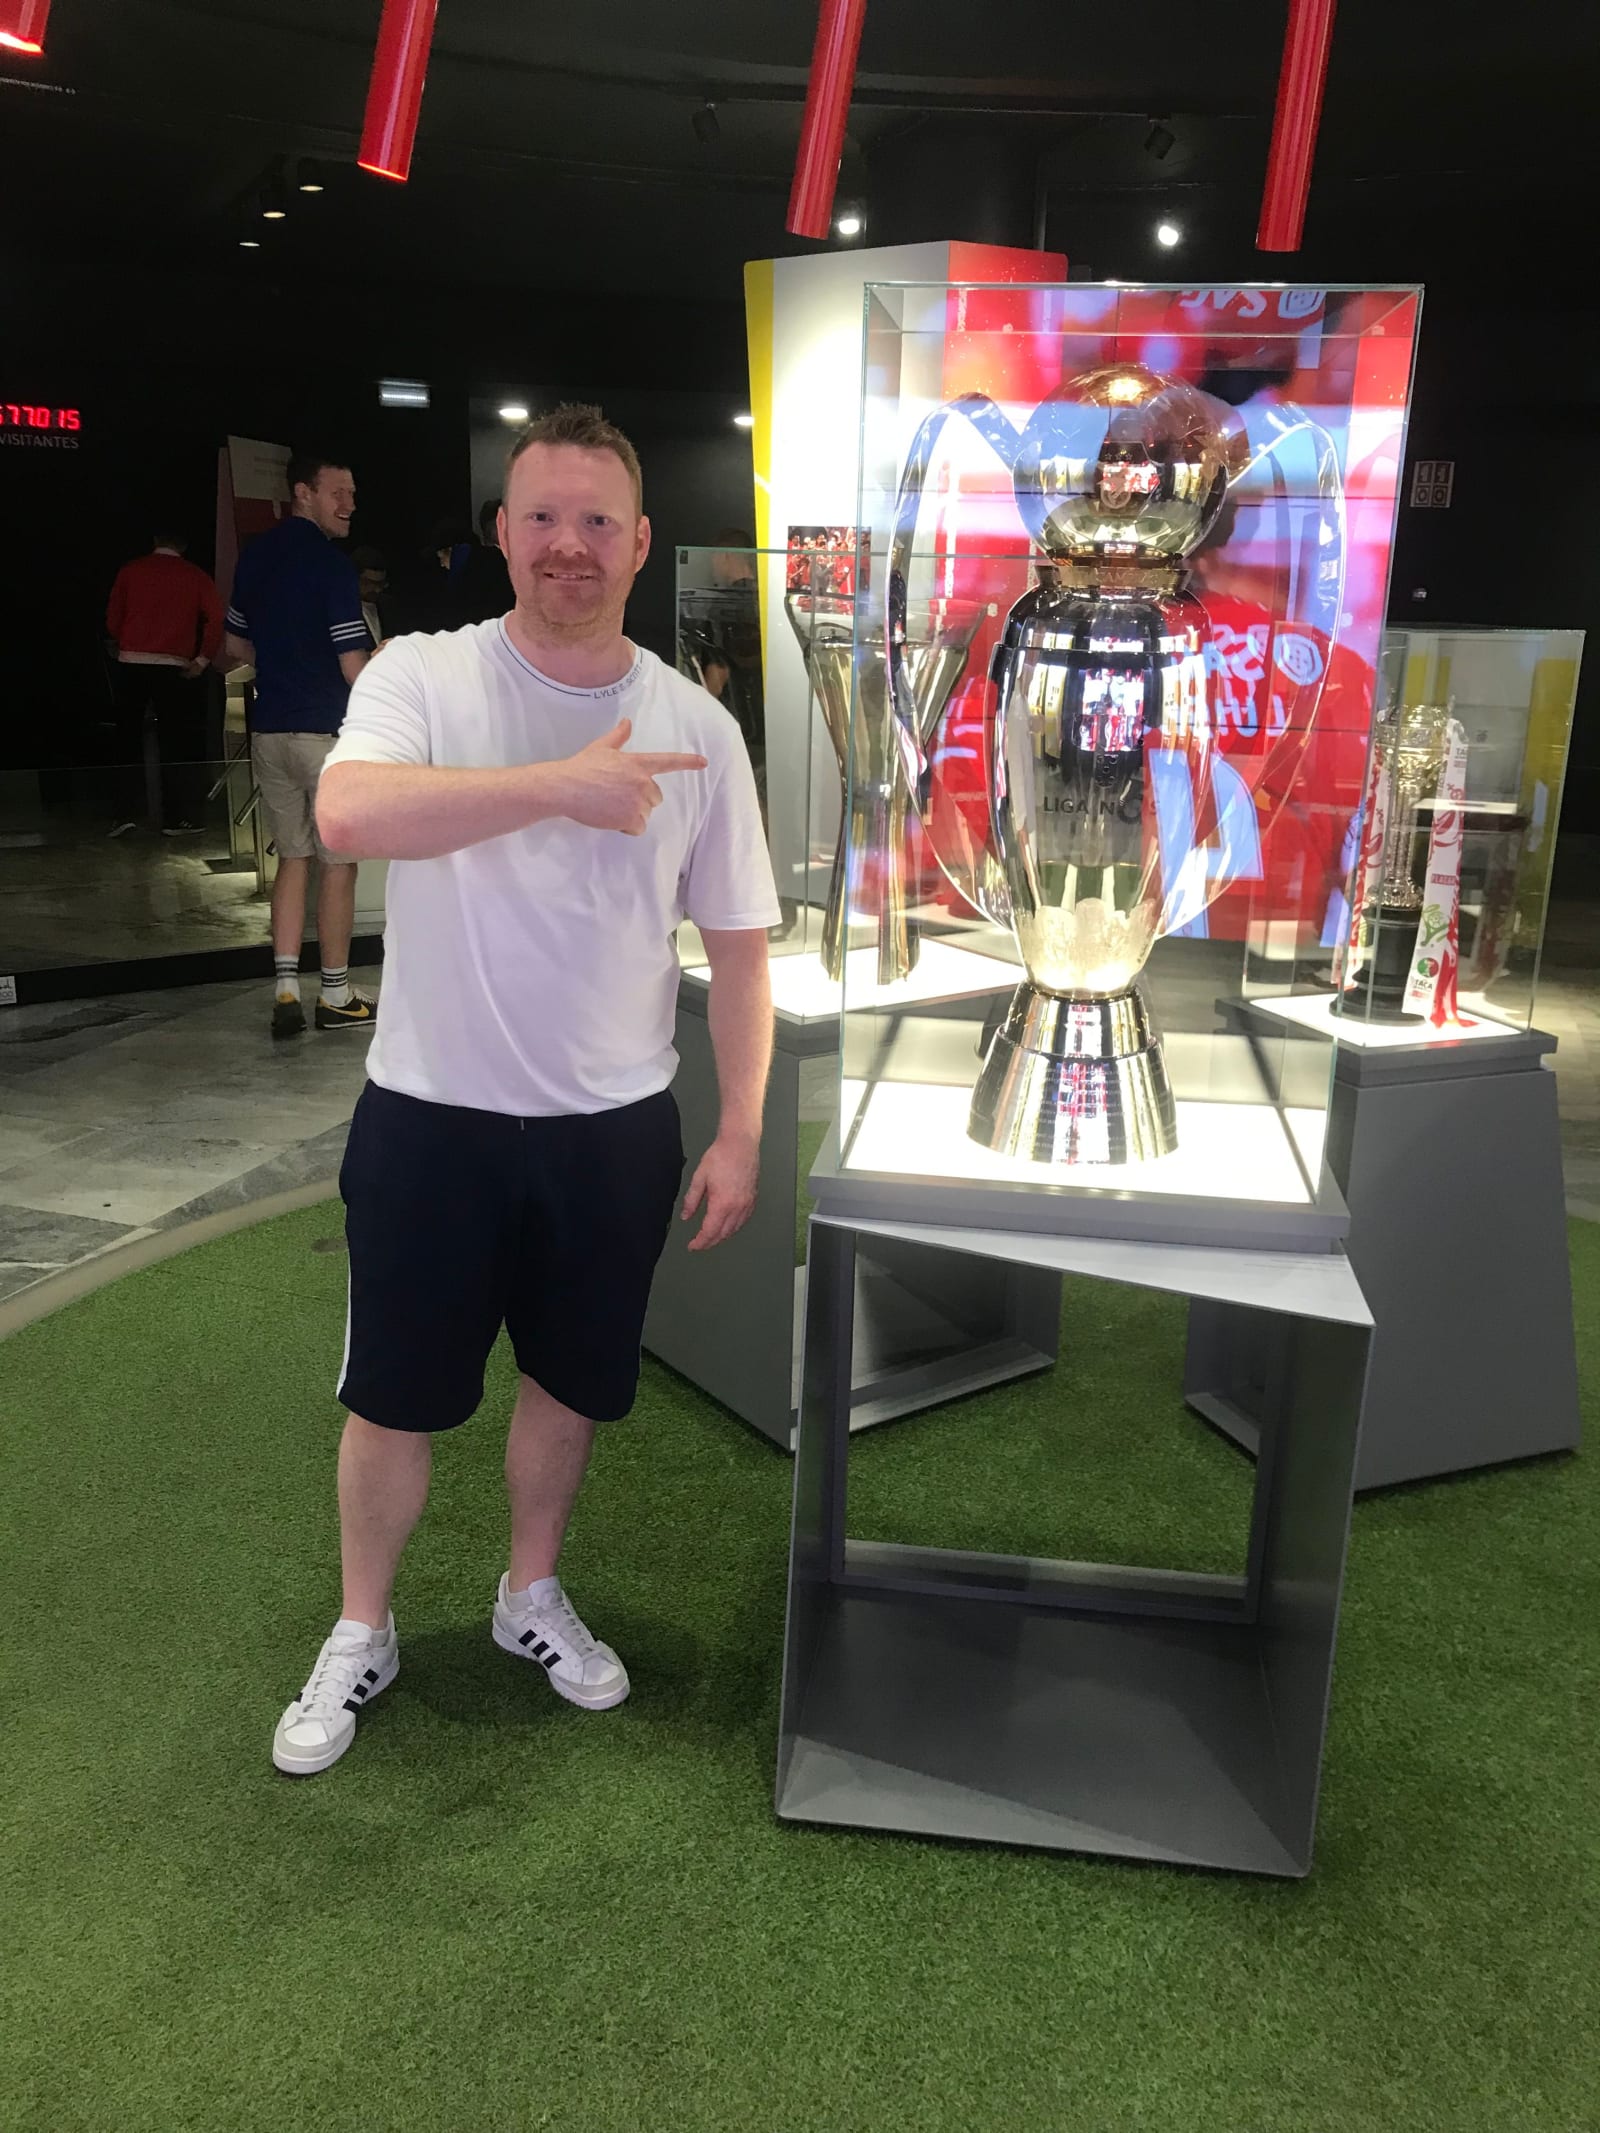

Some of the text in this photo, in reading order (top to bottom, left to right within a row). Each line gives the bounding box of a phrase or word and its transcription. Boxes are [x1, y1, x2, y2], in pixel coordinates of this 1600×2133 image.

[0, 433, 80, 449] VISITANTES
[593, 686, 618, 699] LYLE
[1043, 796, 1090, 815] LIGA
